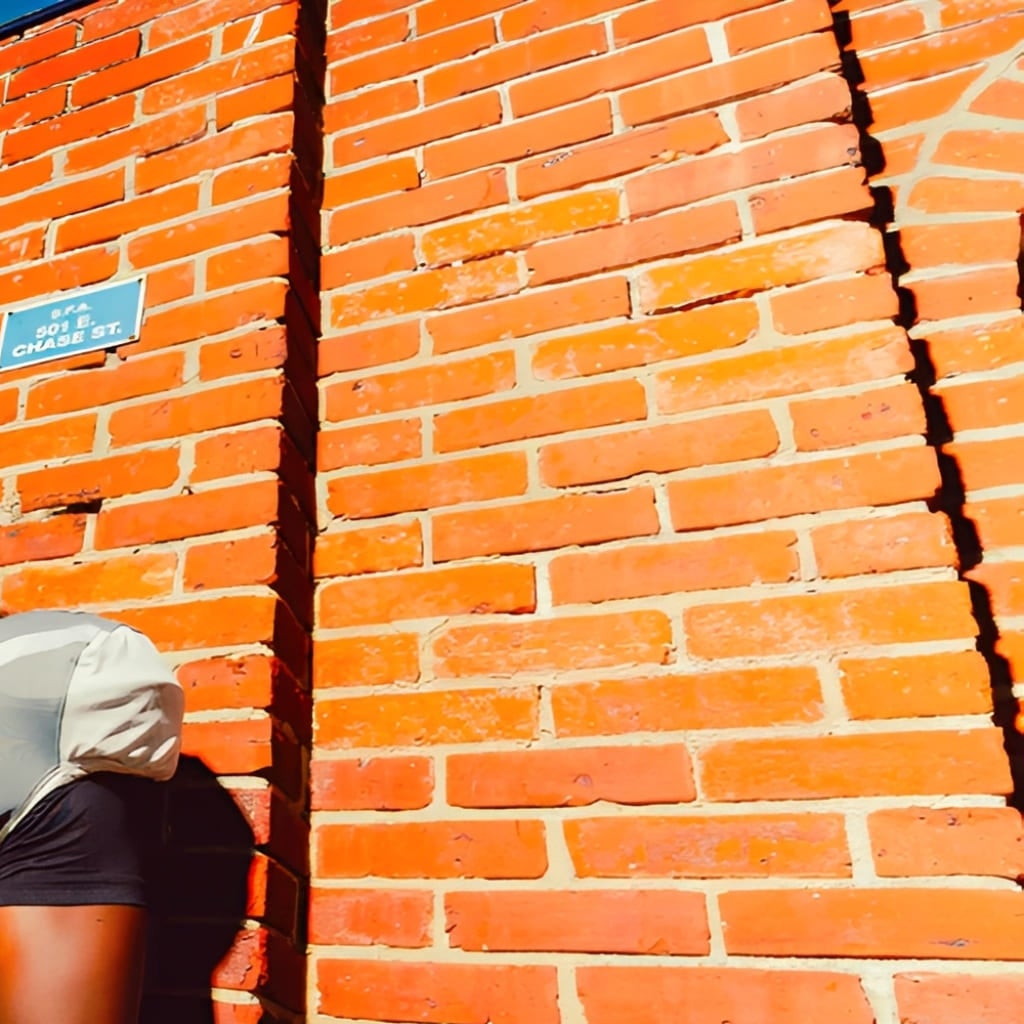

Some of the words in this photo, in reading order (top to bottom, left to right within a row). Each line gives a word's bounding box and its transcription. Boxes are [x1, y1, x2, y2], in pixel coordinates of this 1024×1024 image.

[77, 314, 97, 329] E.
[11, 330, 85, 358] CHASE
[91, 321, 123, 340] ST.
